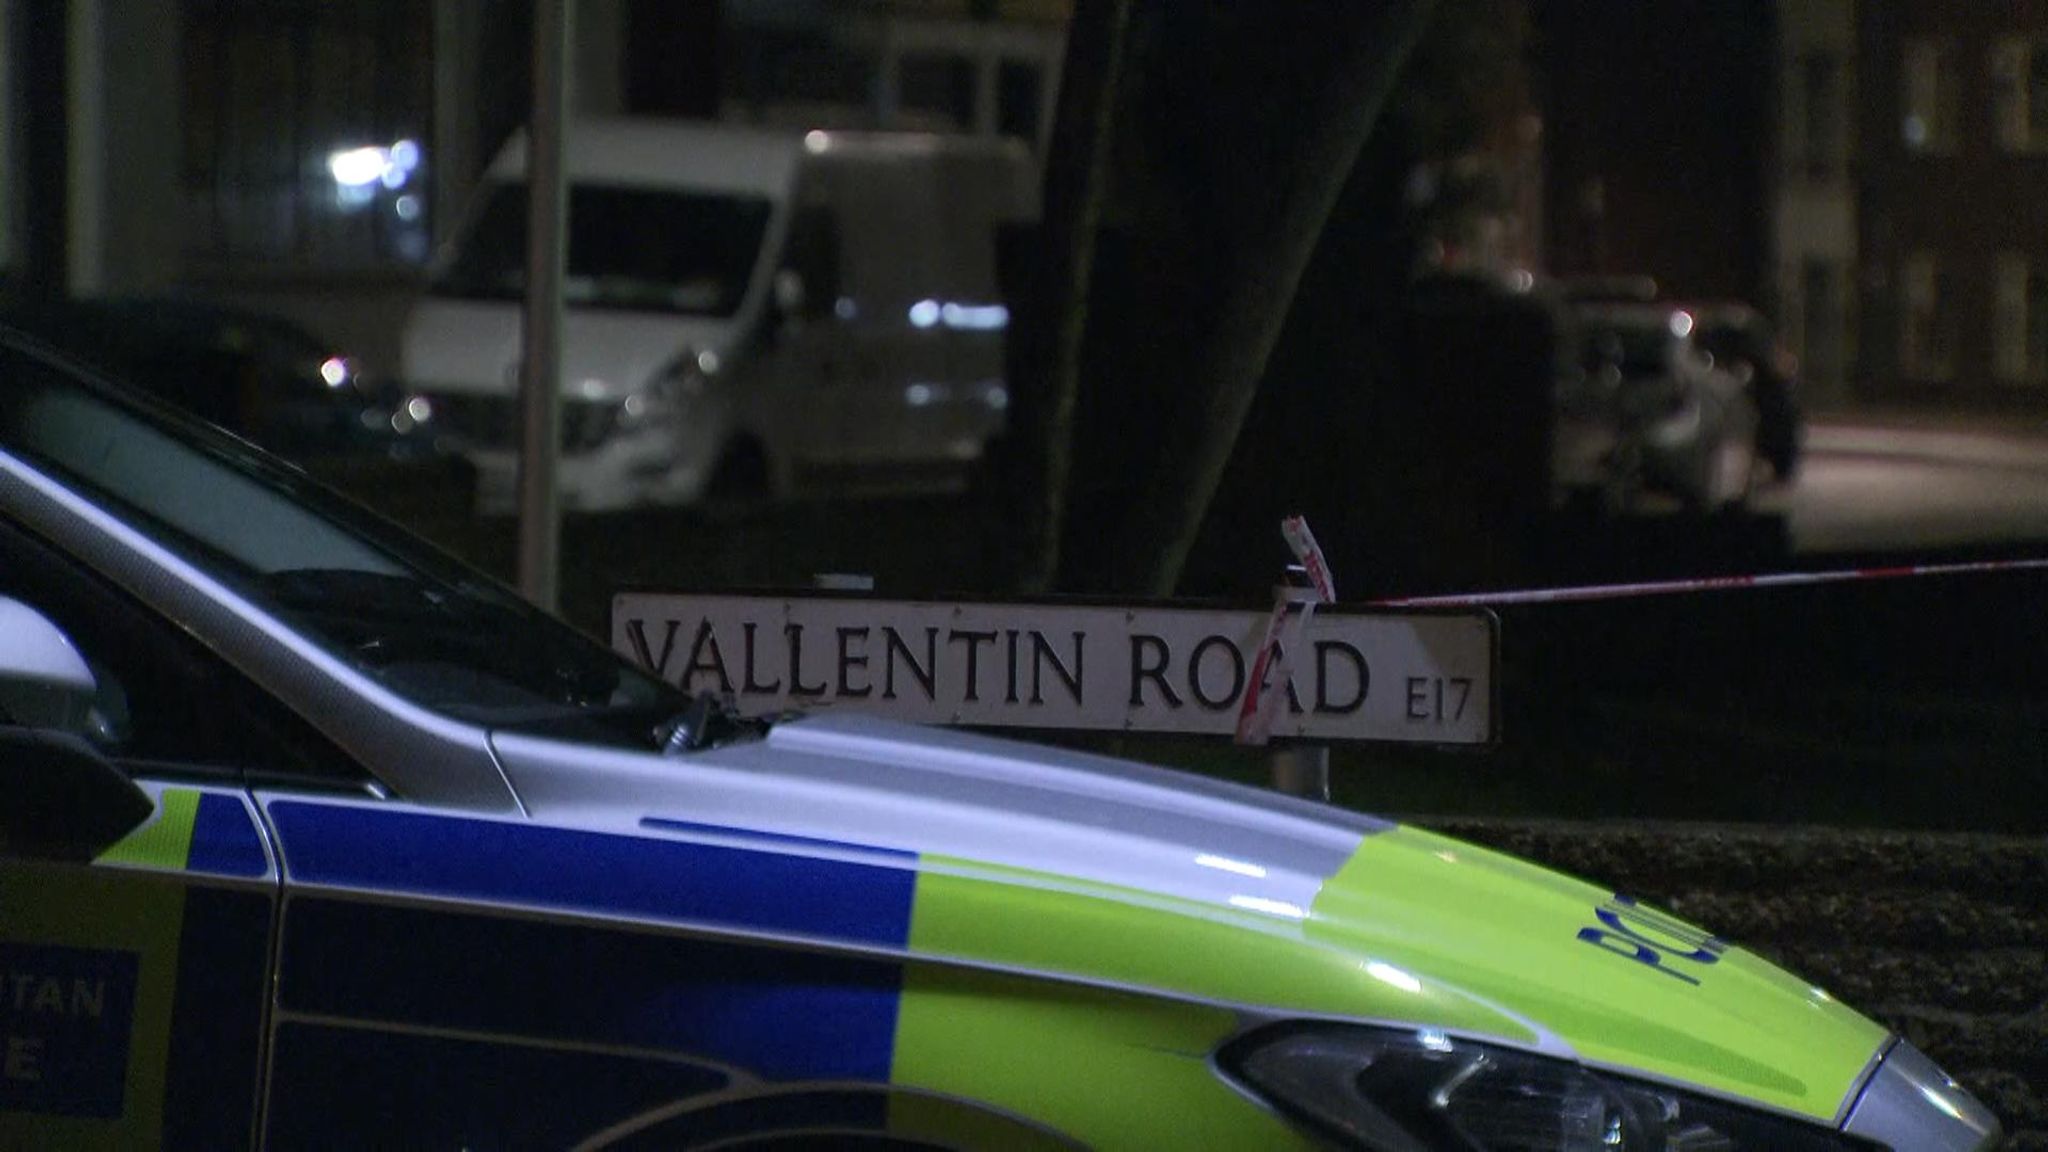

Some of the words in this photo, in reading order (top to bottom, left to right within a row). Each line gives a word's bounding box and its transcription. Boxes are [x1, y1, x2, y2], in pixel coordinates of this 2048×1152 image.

[625, 617, 1086, 706] VALLENTIN
[1128, 635, 1370, 714] ROAD
[1405, 676, 1474, 722] E17
